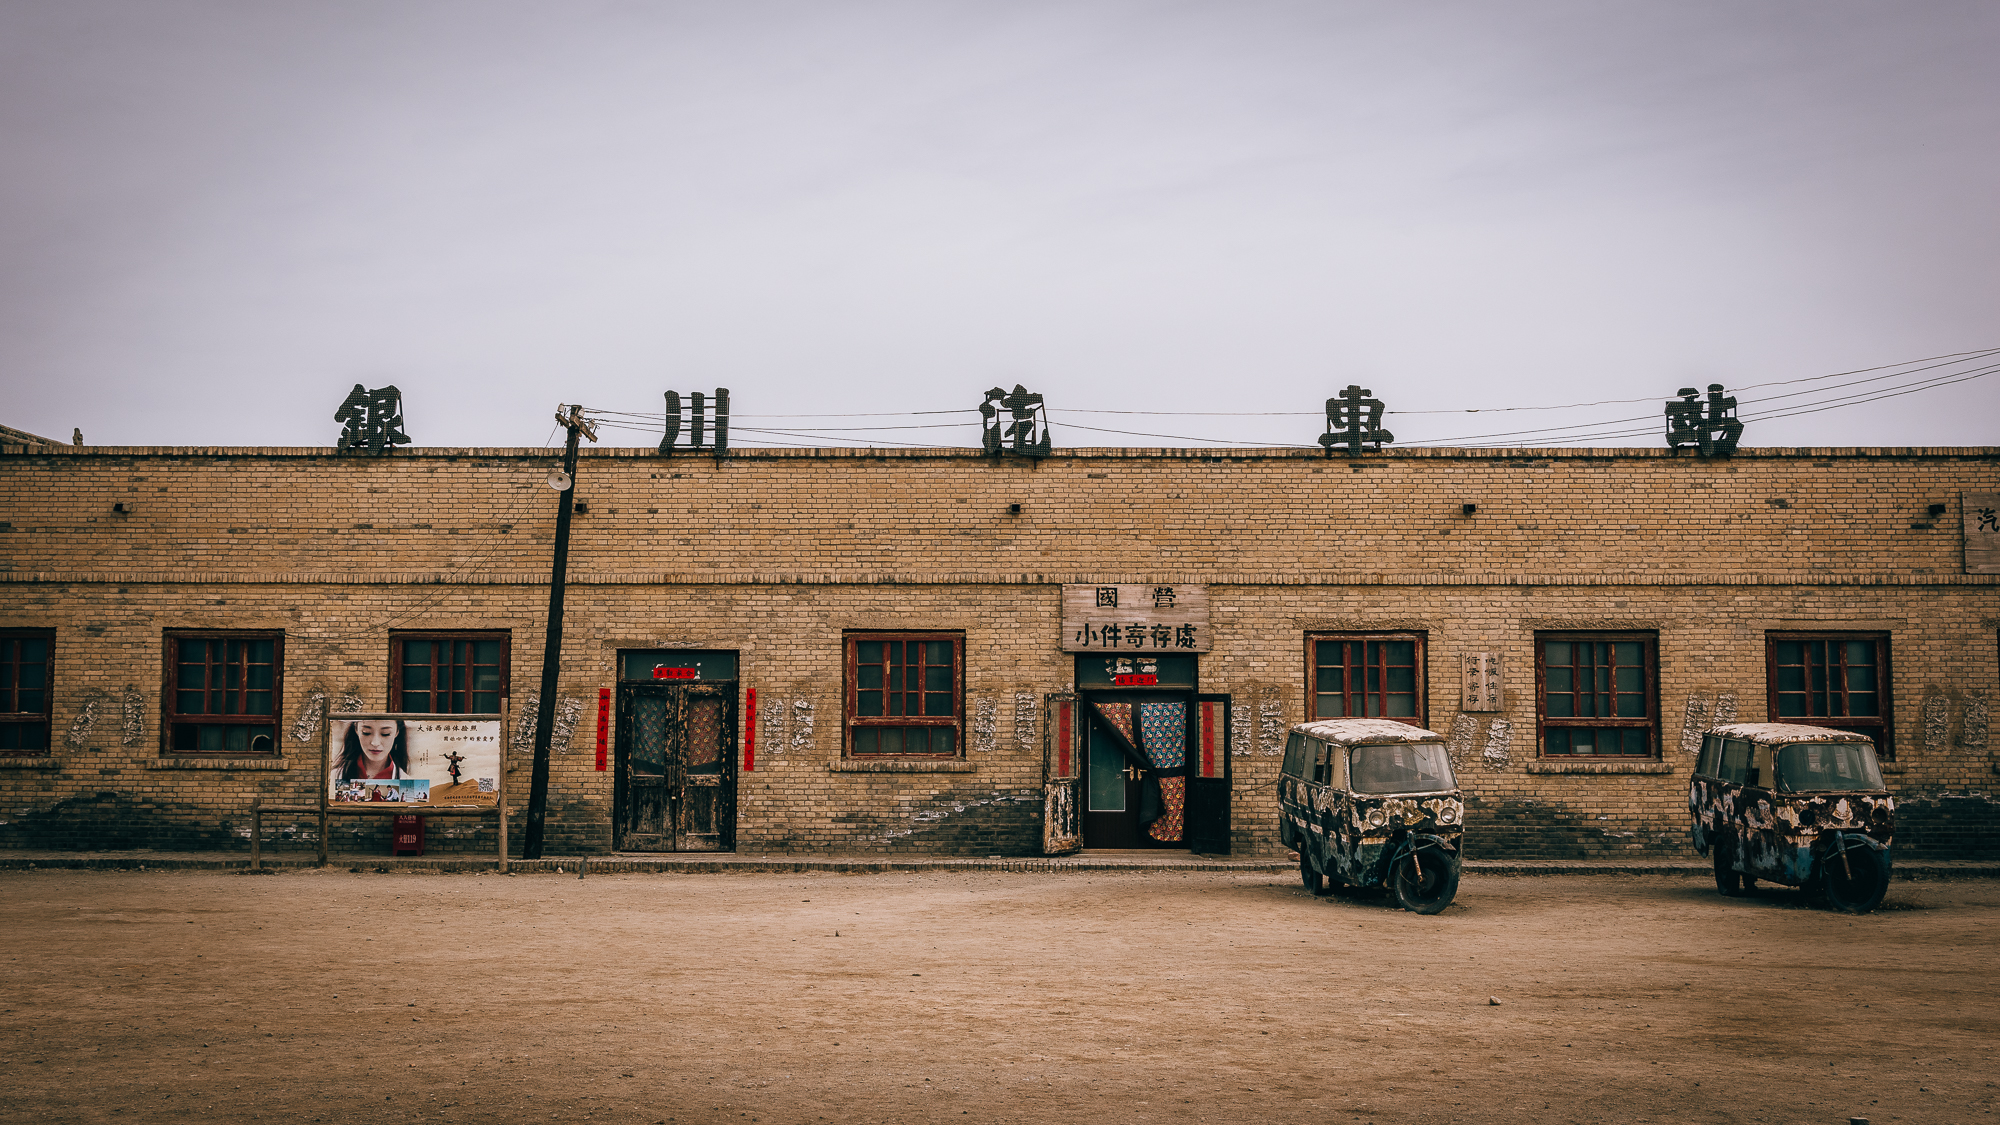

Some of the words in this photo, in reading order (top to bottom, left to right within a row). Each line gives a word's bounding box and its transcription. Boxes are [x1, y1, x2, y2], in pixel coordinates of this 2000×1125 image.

[658, 387, 730, 455] 川
[1318, 385, 1394, 457] 車
[1664, 384, 1744, 457] 站
[1075, 622, 1197, 648] 小件寄存處
[417, 724, 478, 732] 大话西游体验照
